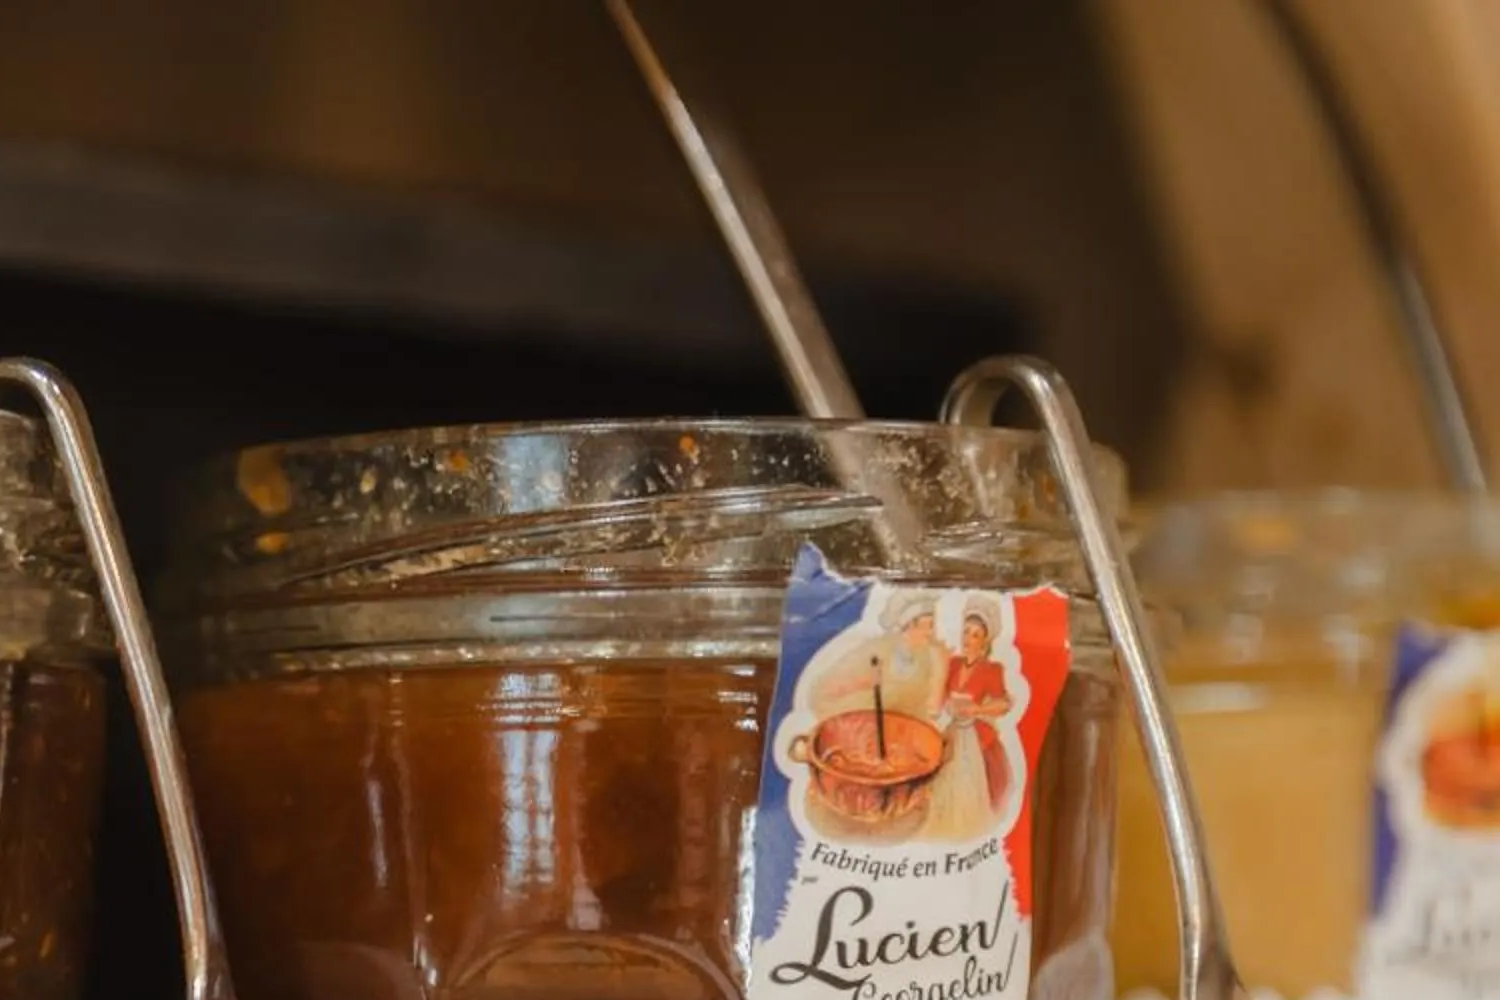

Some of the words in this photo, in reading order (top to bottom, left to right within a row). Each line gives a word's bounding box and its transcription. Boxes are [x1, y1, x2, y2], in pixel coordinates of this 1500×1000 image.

[810, 842, 909, 881] Fabriqué
[913, 860, 937, 878] en
[944, 837, 998, 875] France
[769, 879, 1009, 991] Lucien
